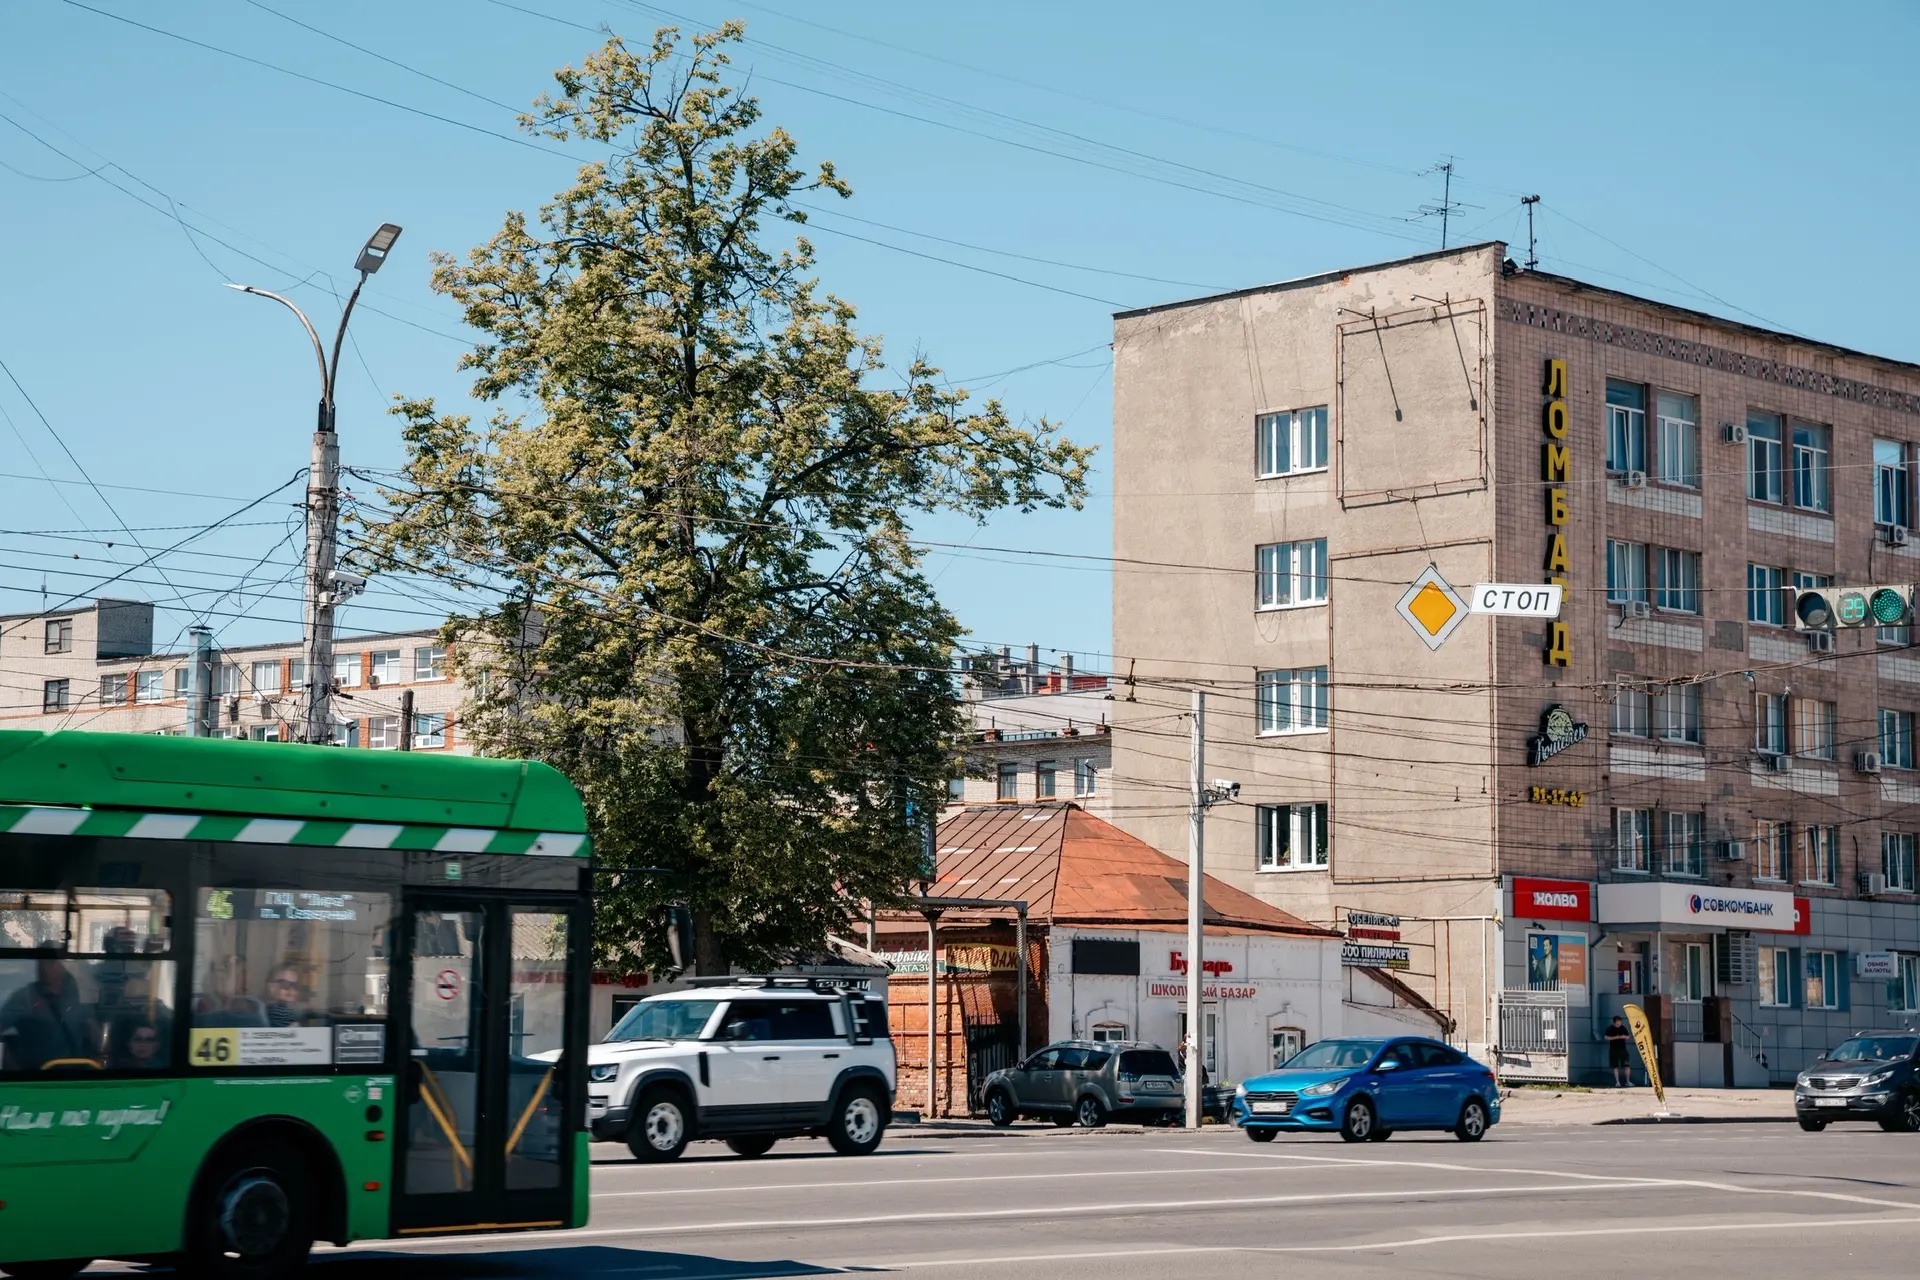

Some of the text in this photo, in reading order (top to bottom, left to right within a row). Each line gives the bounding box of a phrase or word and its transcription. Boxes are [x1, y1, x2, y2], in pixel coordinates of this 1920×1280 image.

[1483, 589, 1550, 611] СТОП
[1703, 897, 1774, 917] СОВКОМБАНК
[946, 944, 1018, 969] РАСПРОДАЖ
[1169, 951, 1233, 977] Буварь
[1341, 946, 1410, 960] ООО ПИЛМАРКЕТ
[1151, 983, 1256, 999] ШКОЛЫЙ БАЗАР
[194, 1036, 231, 1062] 46
